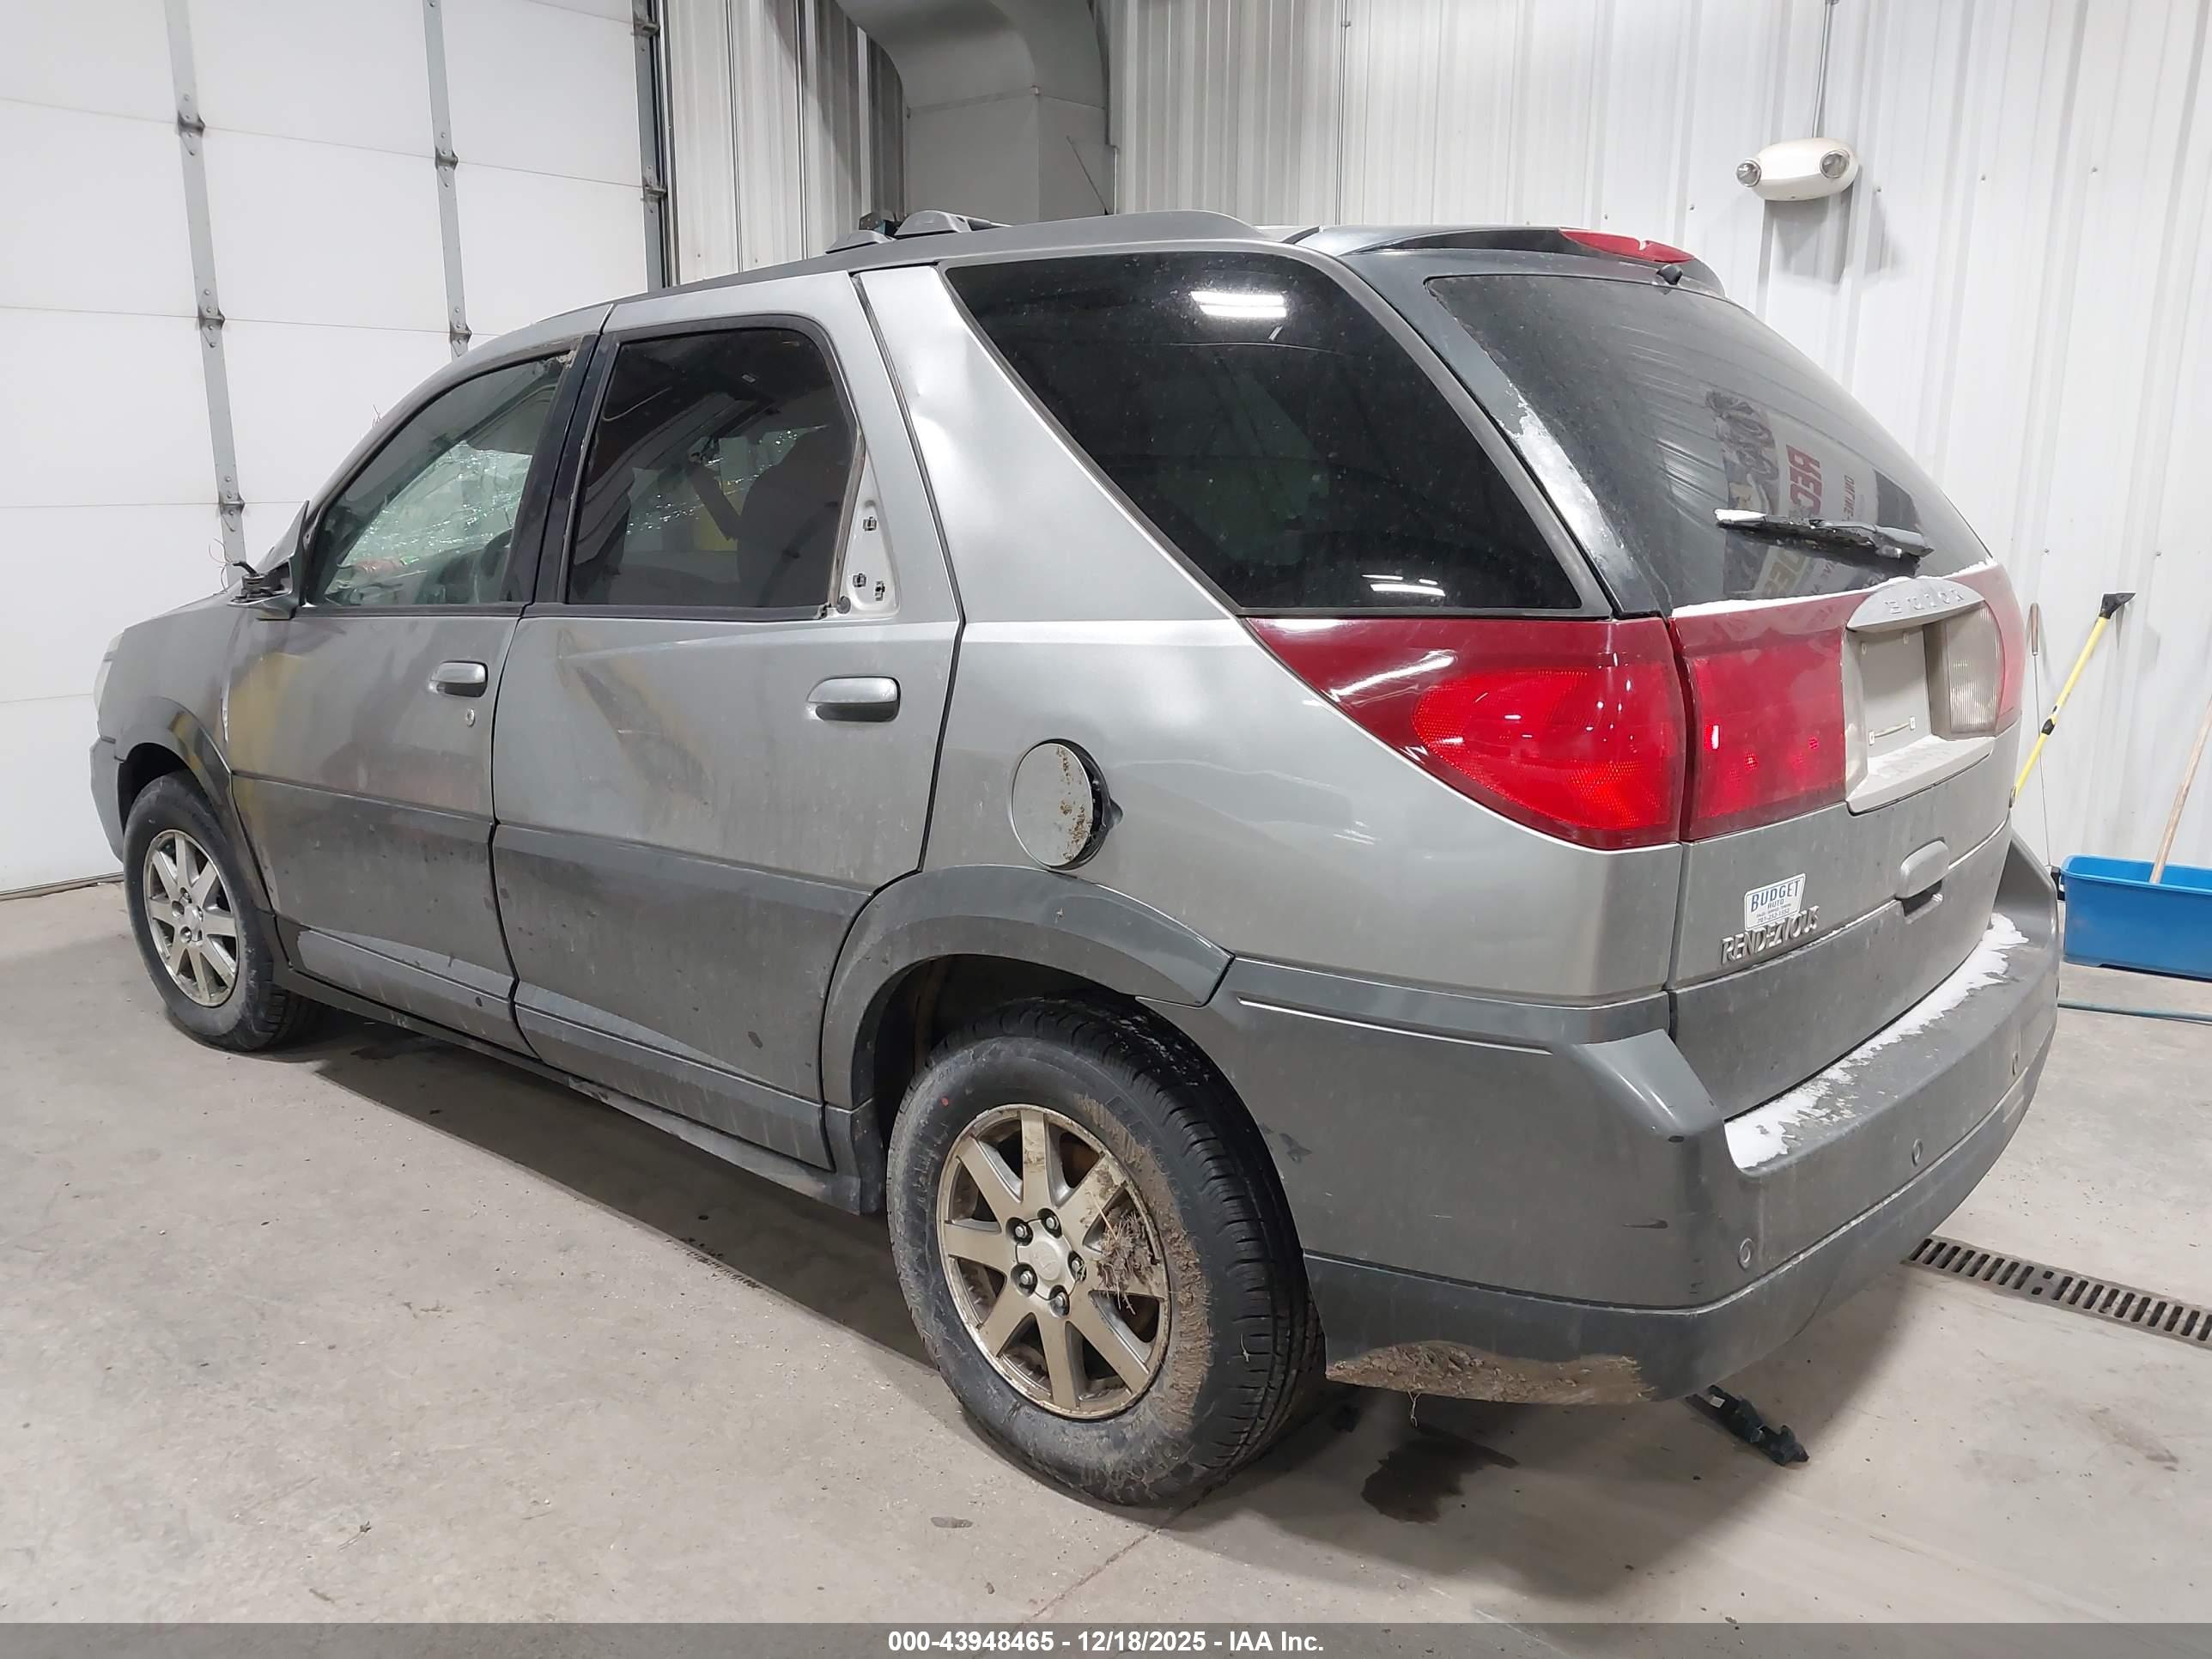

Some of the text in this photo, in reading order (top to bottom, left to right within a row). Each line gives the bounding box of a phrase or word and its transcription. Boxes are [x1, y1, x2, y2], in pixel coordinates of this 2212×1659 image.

[1751, 880, 1801, 912] BUDGET
[1767, 899, 1784, 909] AUTO
[1720, 906, 1819, 964] RENDEZVOUS
